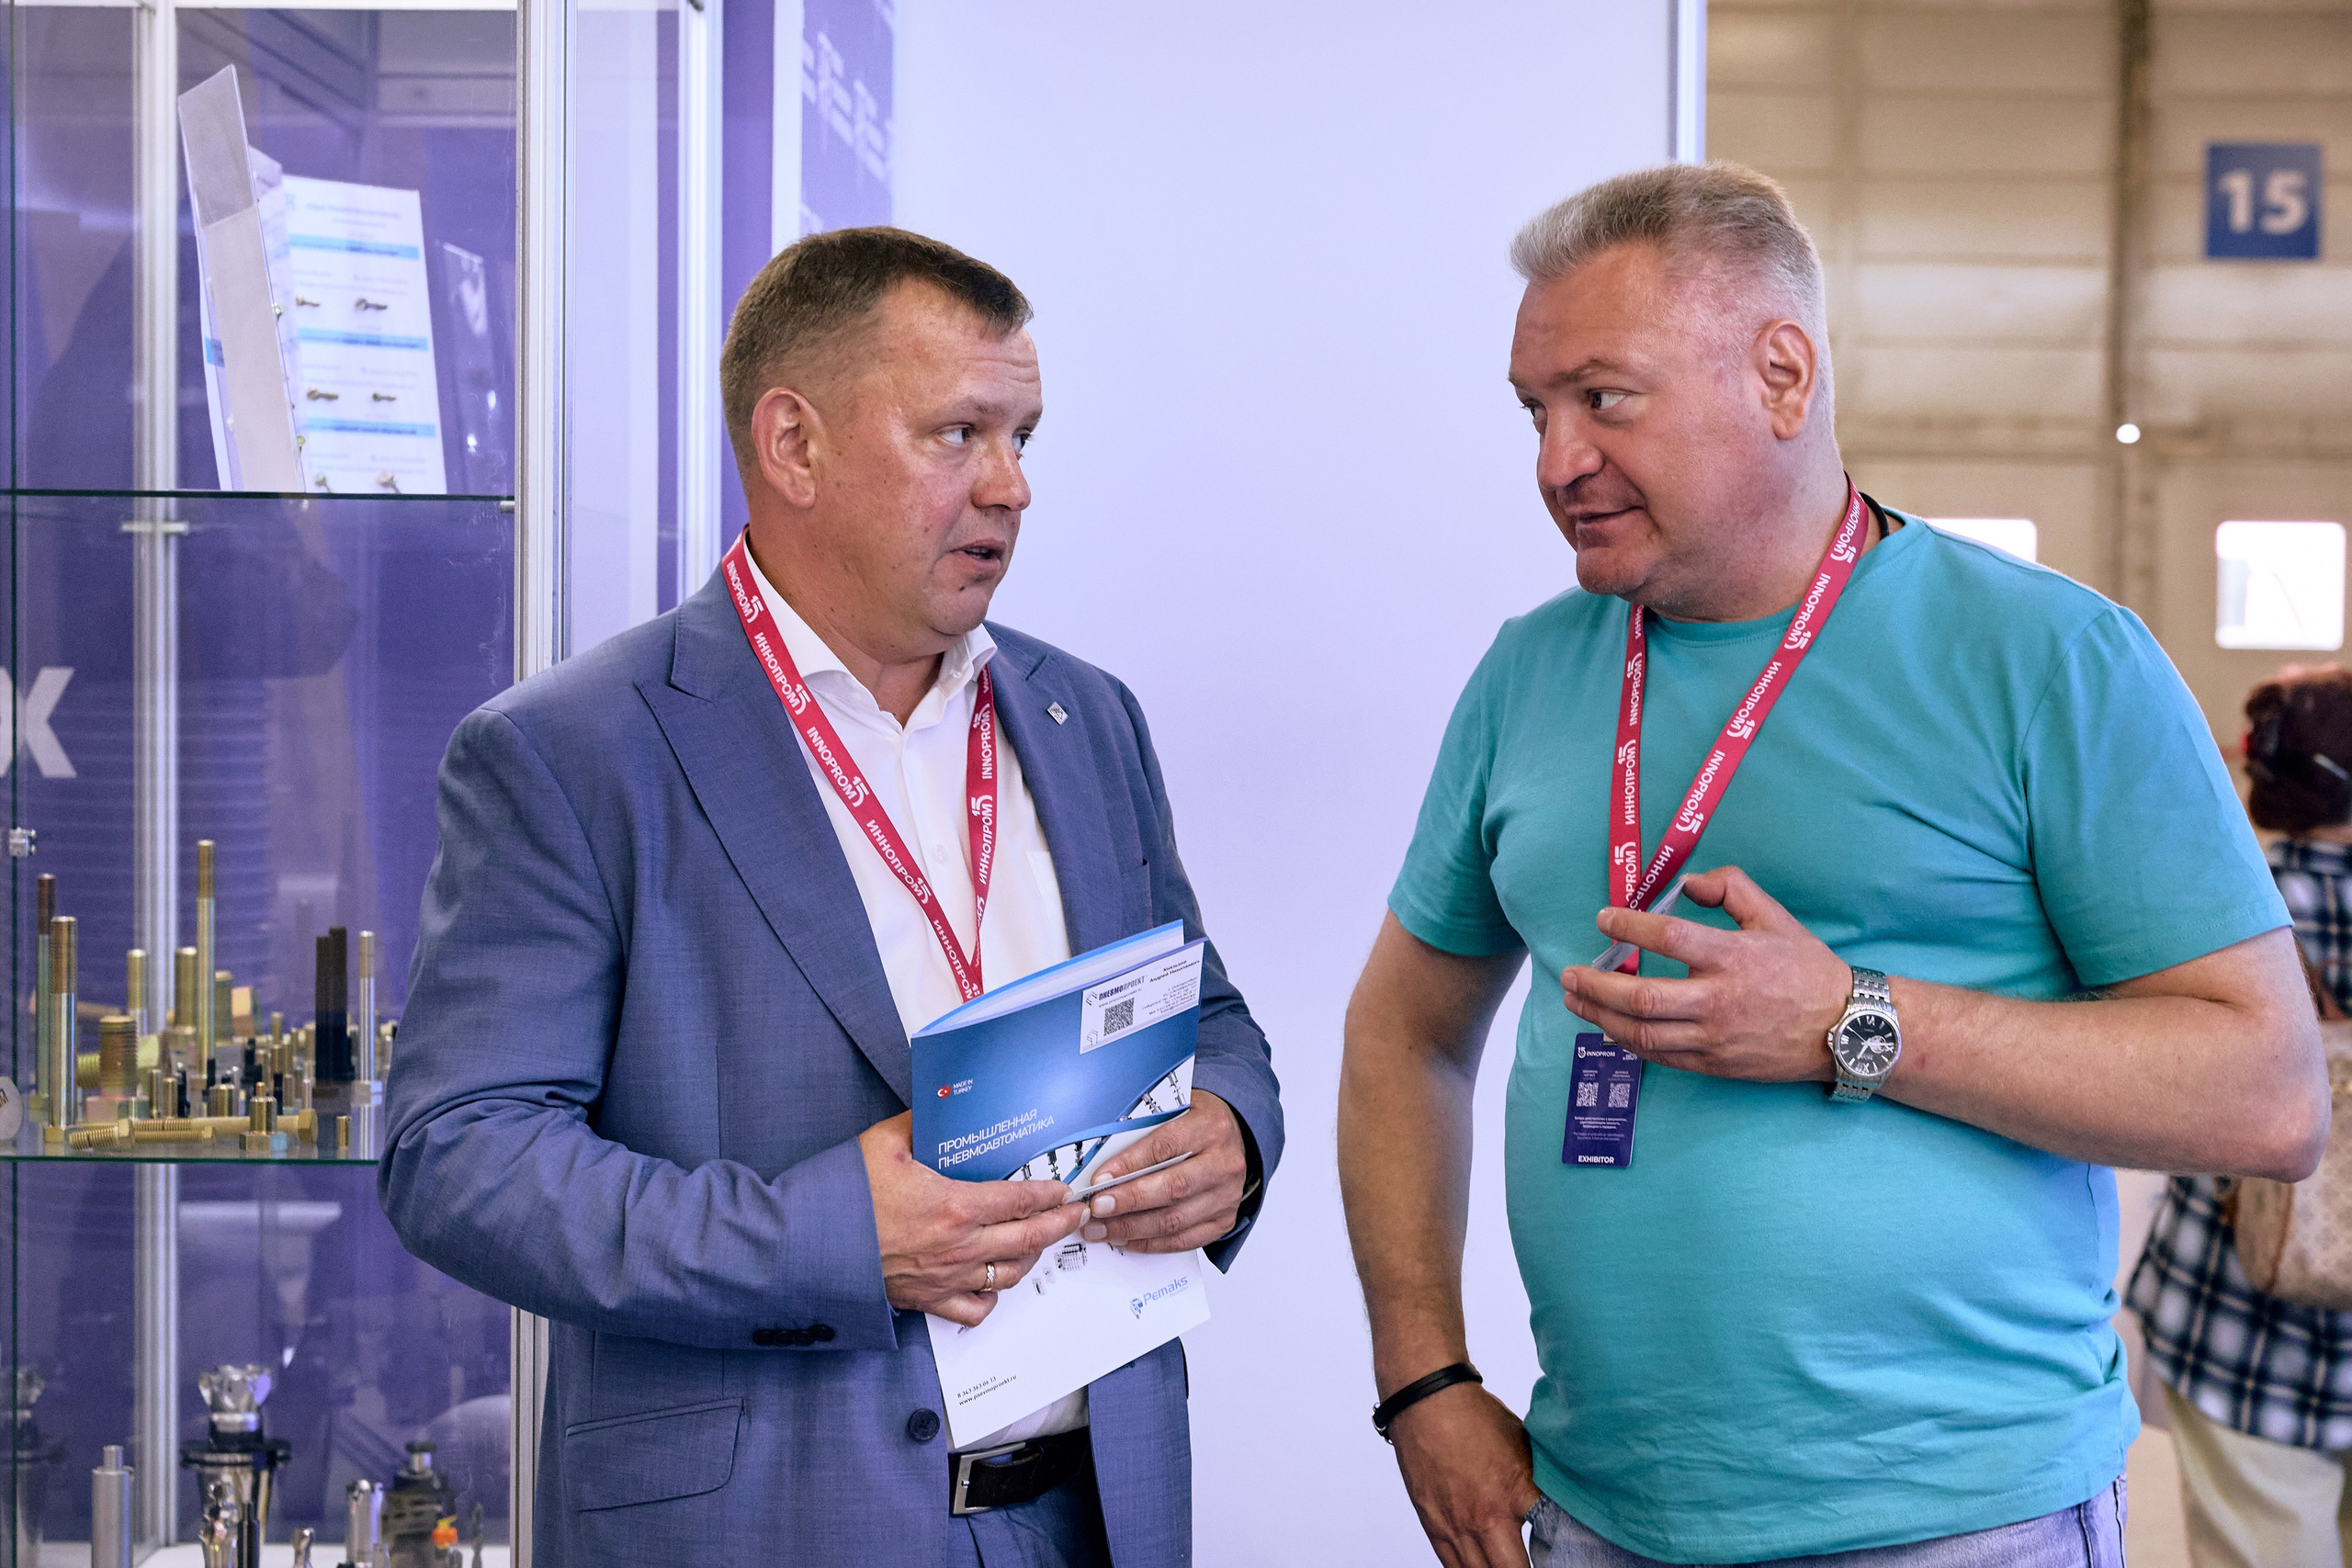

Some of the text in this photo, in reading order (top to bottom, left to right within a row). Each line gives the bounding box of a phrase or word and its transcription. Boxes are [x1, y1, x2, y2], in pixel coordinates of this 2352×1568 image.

[2218, 169, 2308, 234] 15
[1833, 497, 1860, 555] ИННОПРОМ
[726, 560, 753, 619] INNOPROM
[1788, 572, 1831, 643] INNOPROM
[754, 632, 800, 711] ИННОПРОМ
[1629, 660, 1642, 727] INNOPROM
[1731, 660, 1781, 730] ИННОПРОМ
[807, 726, 857, 800] INNOPROM
[980, 710, 992, 779] INNOPROM
[1625, 748, 1635, 825] ИННОПРОМ
[1679, 750, 1725, 824] INNOPROM
[865, 819, 923, 898] ИННОПРОМ
[979, 806, 992, 885] ИННОПРОМ
[1625, 852, 1636, 902] OPROM
[1629, 844, 1675, 912] ИННОПРО
[1099, 976, 1145, 1001] ПНЕВМОПРОЕКТ
[954, 1080, 967, 1089] MADE
[938, 1109, 1037, 1155] ПРОМЫШЛЕННАЯ
[938, 1115, 1055, 1169] ПНЕВМОАВТОМАТИКА
[1577, 1155, 1614, 1164] EXHIBITOR
[1142, 1276, 1188, 1306] Pemaks
